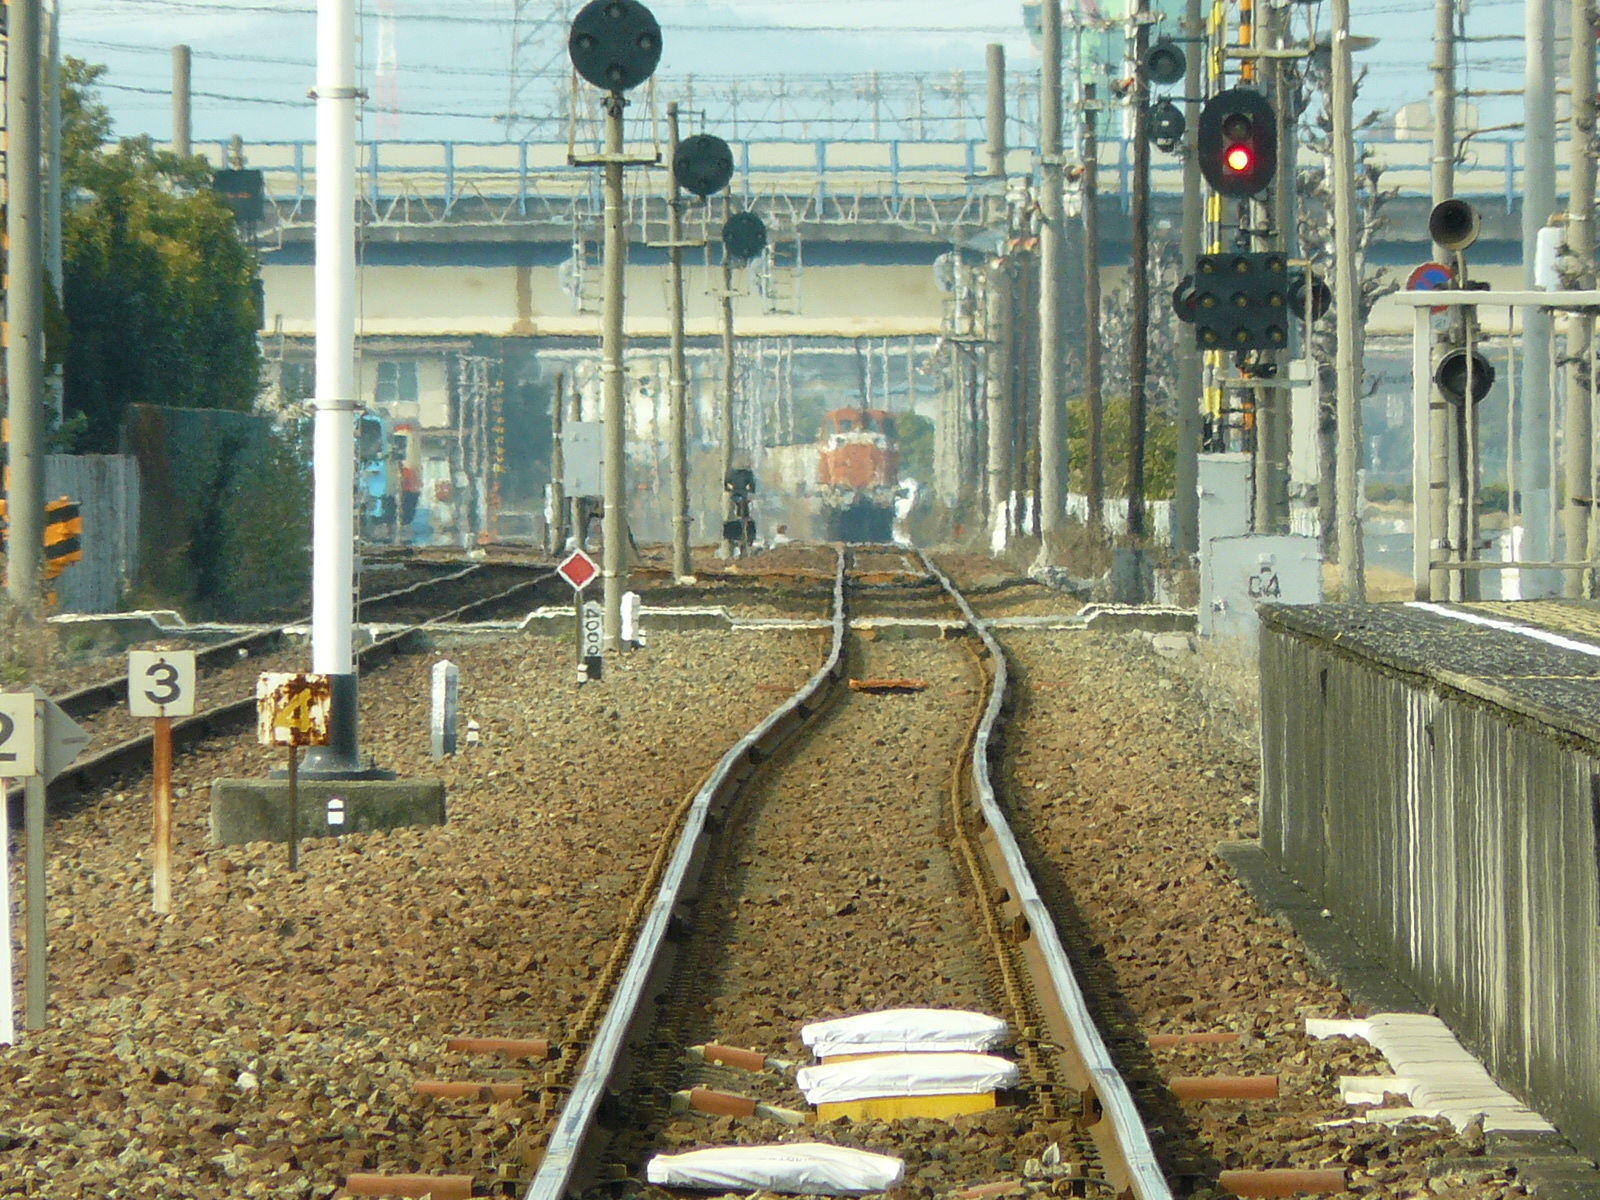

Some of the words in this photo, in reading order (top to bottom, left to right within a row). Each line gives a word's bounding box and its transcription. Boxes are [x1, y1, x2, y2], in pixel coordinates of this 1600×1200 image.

[585, 609, 600, 655] 4000
[145, 663, 181, 705] 3
[273, 688, 312, 732] 4
